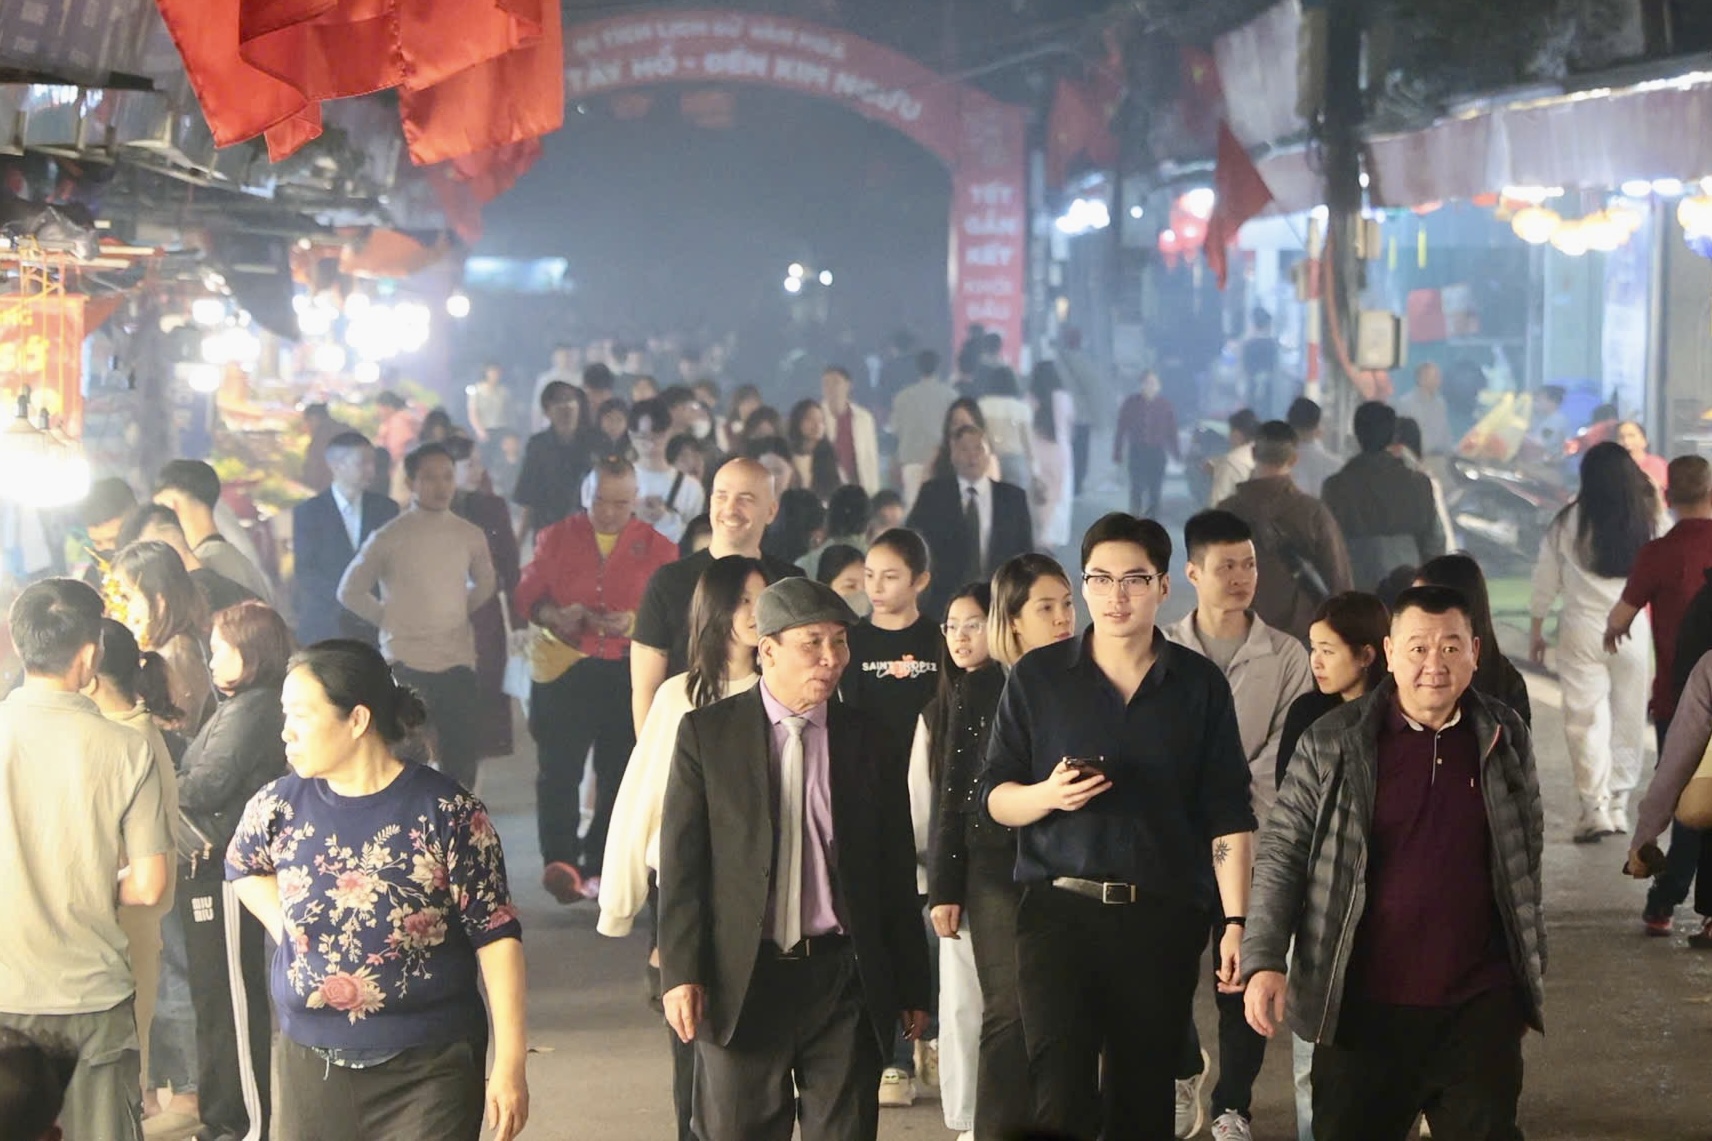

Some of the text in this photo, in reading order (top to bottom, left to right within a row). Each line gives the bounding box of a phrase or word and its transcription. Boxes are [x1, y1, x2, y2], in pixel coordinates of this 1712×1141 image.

[774, 54, 829, 87] KIM
[191, 896, 213, 910] MIU
[193, 908, 214, 922] MIU
